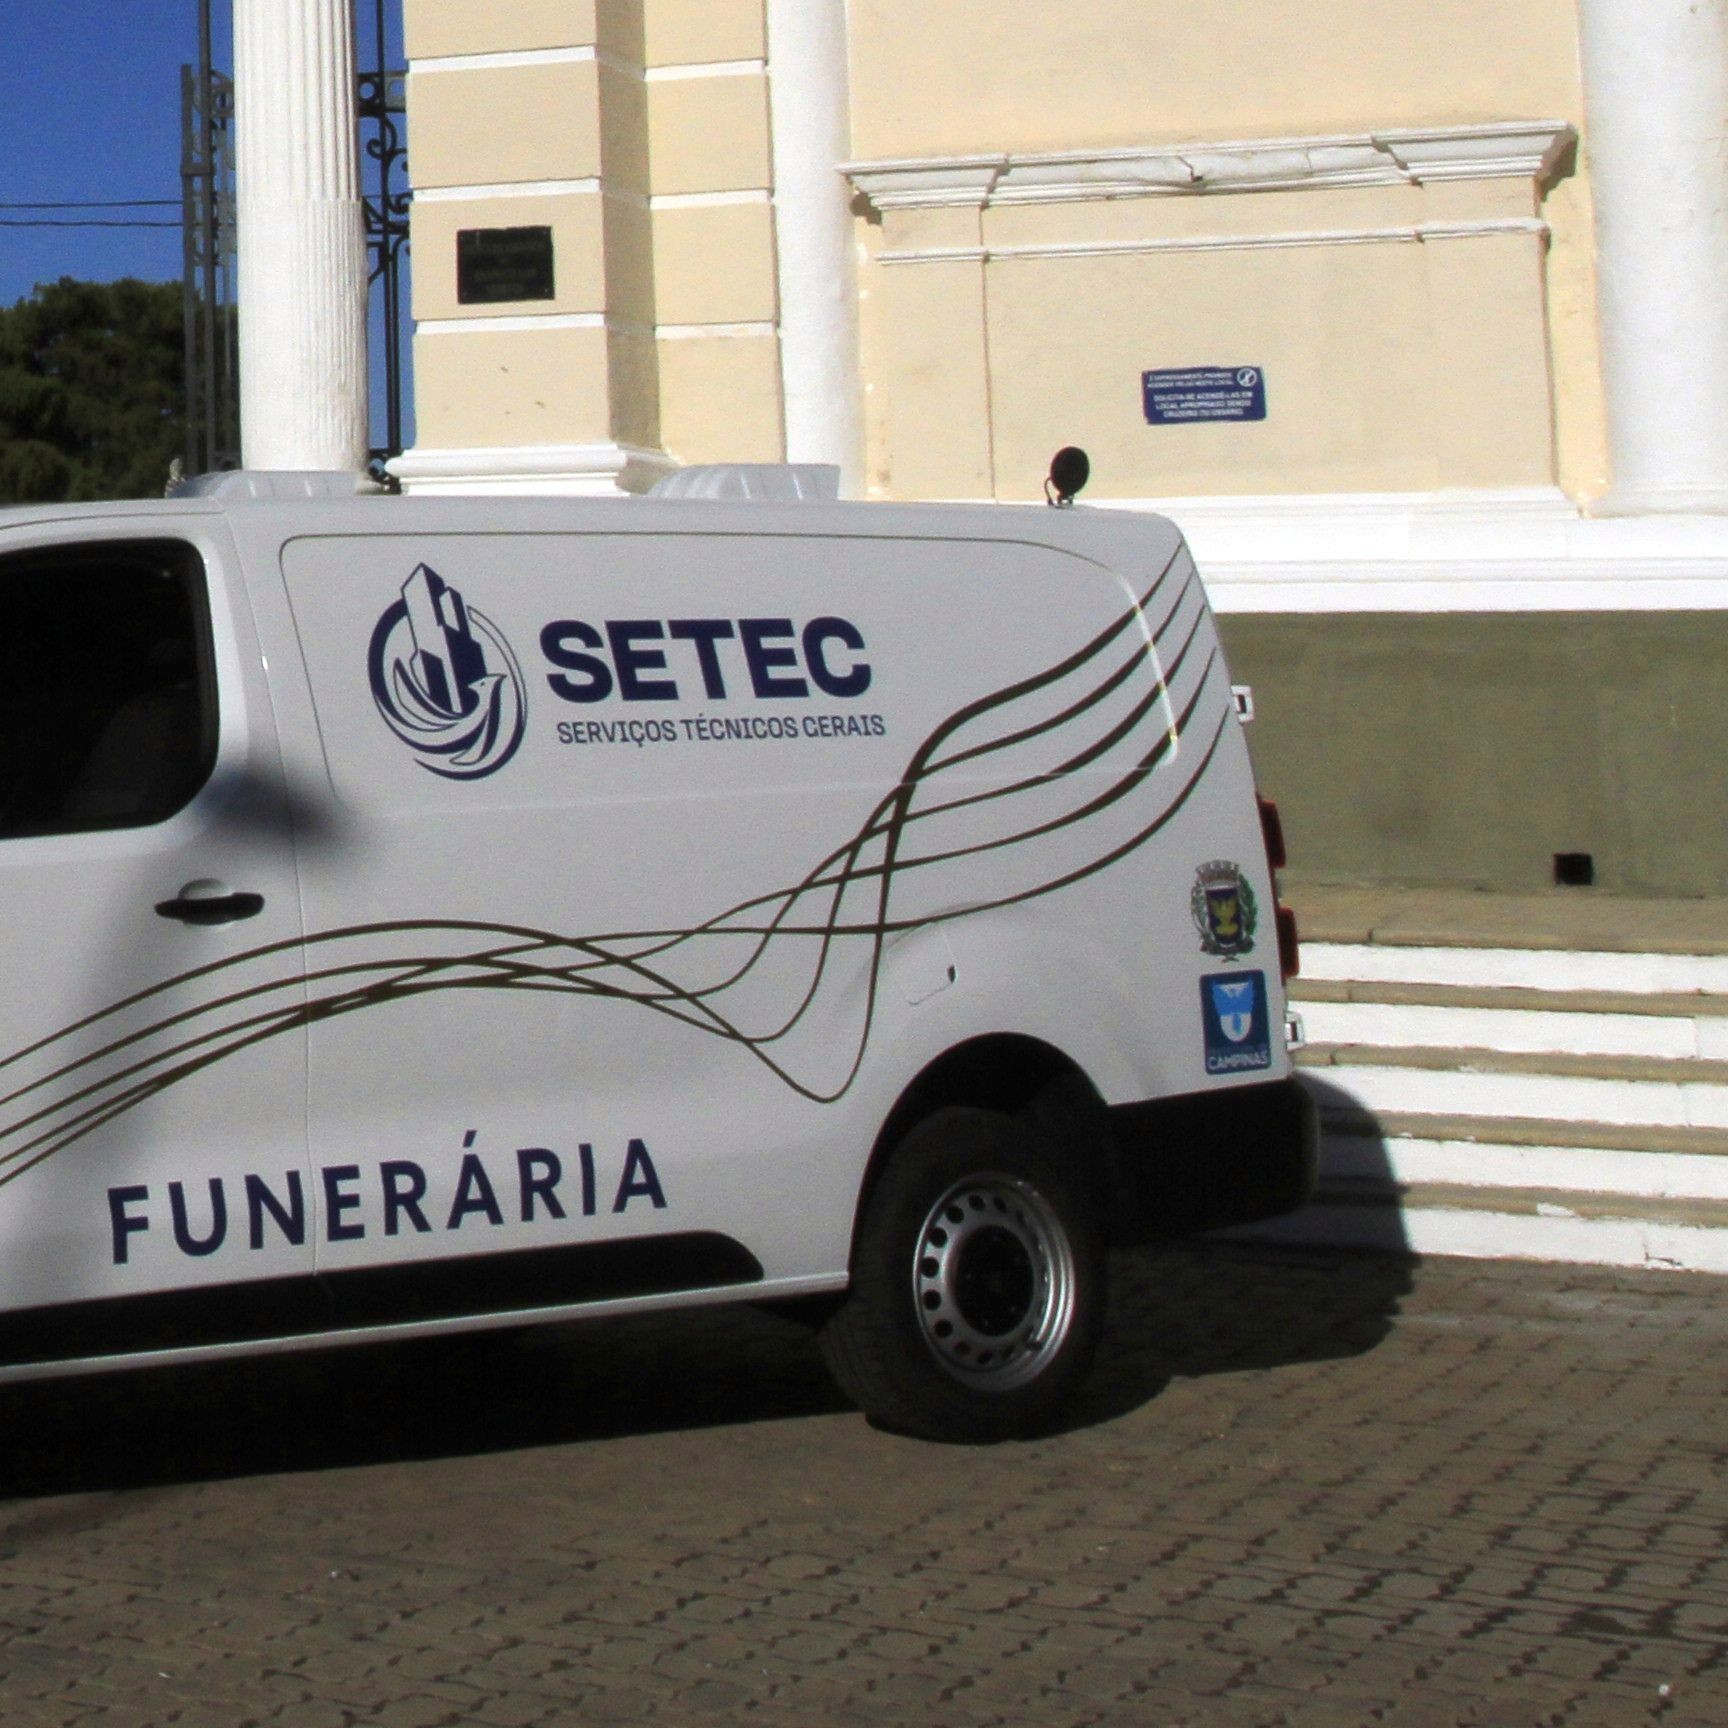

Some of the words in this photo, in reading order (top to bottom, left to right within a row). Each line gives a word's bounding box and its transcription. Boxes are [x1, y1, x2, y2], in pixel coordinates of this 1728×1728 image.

[539, 616, 872, 704] SETEC
[556, 720, 678, 748] SERVIÇOS
[679, 713, 798, 741] TÉCNICOS
[802, 714, 887, 738] GERAIS
[107, 1129, 668, 1266] FUNERÁRIA
